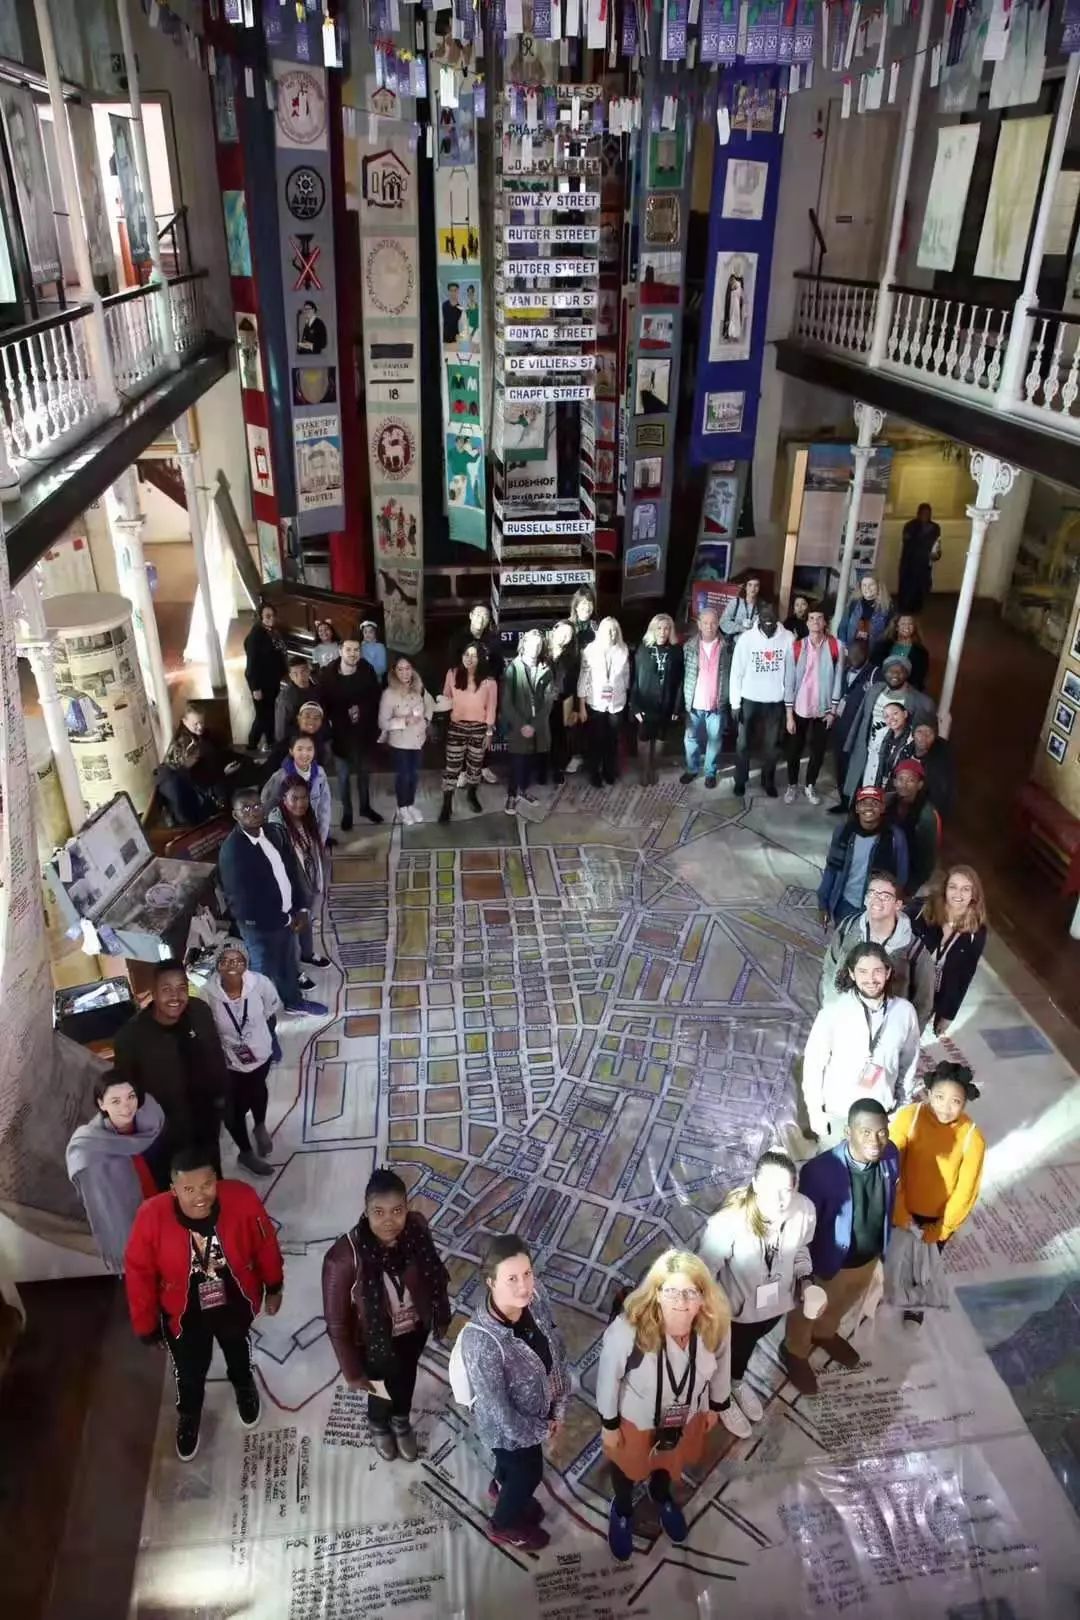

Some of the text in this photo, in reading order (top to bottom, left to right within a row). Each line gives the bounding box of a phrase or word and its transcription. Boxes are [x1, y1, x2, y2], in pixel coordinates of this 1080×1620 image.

[557, 194, 597, 206] STREET
[508, 229, 597, 240] RUTGER STREET
[508, 262, 596, 275] RUTGER STREET
[510, 295, 531, 306] VAN
[534, 295, 548, 306] DE
[509, 327, 593, 338] PONTAC STREET
[510, 359, 525, 369] DE
[528, 358, 577, 369] VILLIERS
[389, 388, 399, 400] 18
[509, 387, 591, 399] CHAPEL STREET
[507, 522, 590, 533] RUSSELL STREET
[505, 572, 591, 583] ASPELING STREET
[286, 1538, 309, 1550] FOR
[314, 1535, 328, 1545] THE
[335, 1526, 373, 1541] MOTHER
[401, 1517, 426, 1529] SON
[340, 1539, 362, 1550] DEAD
